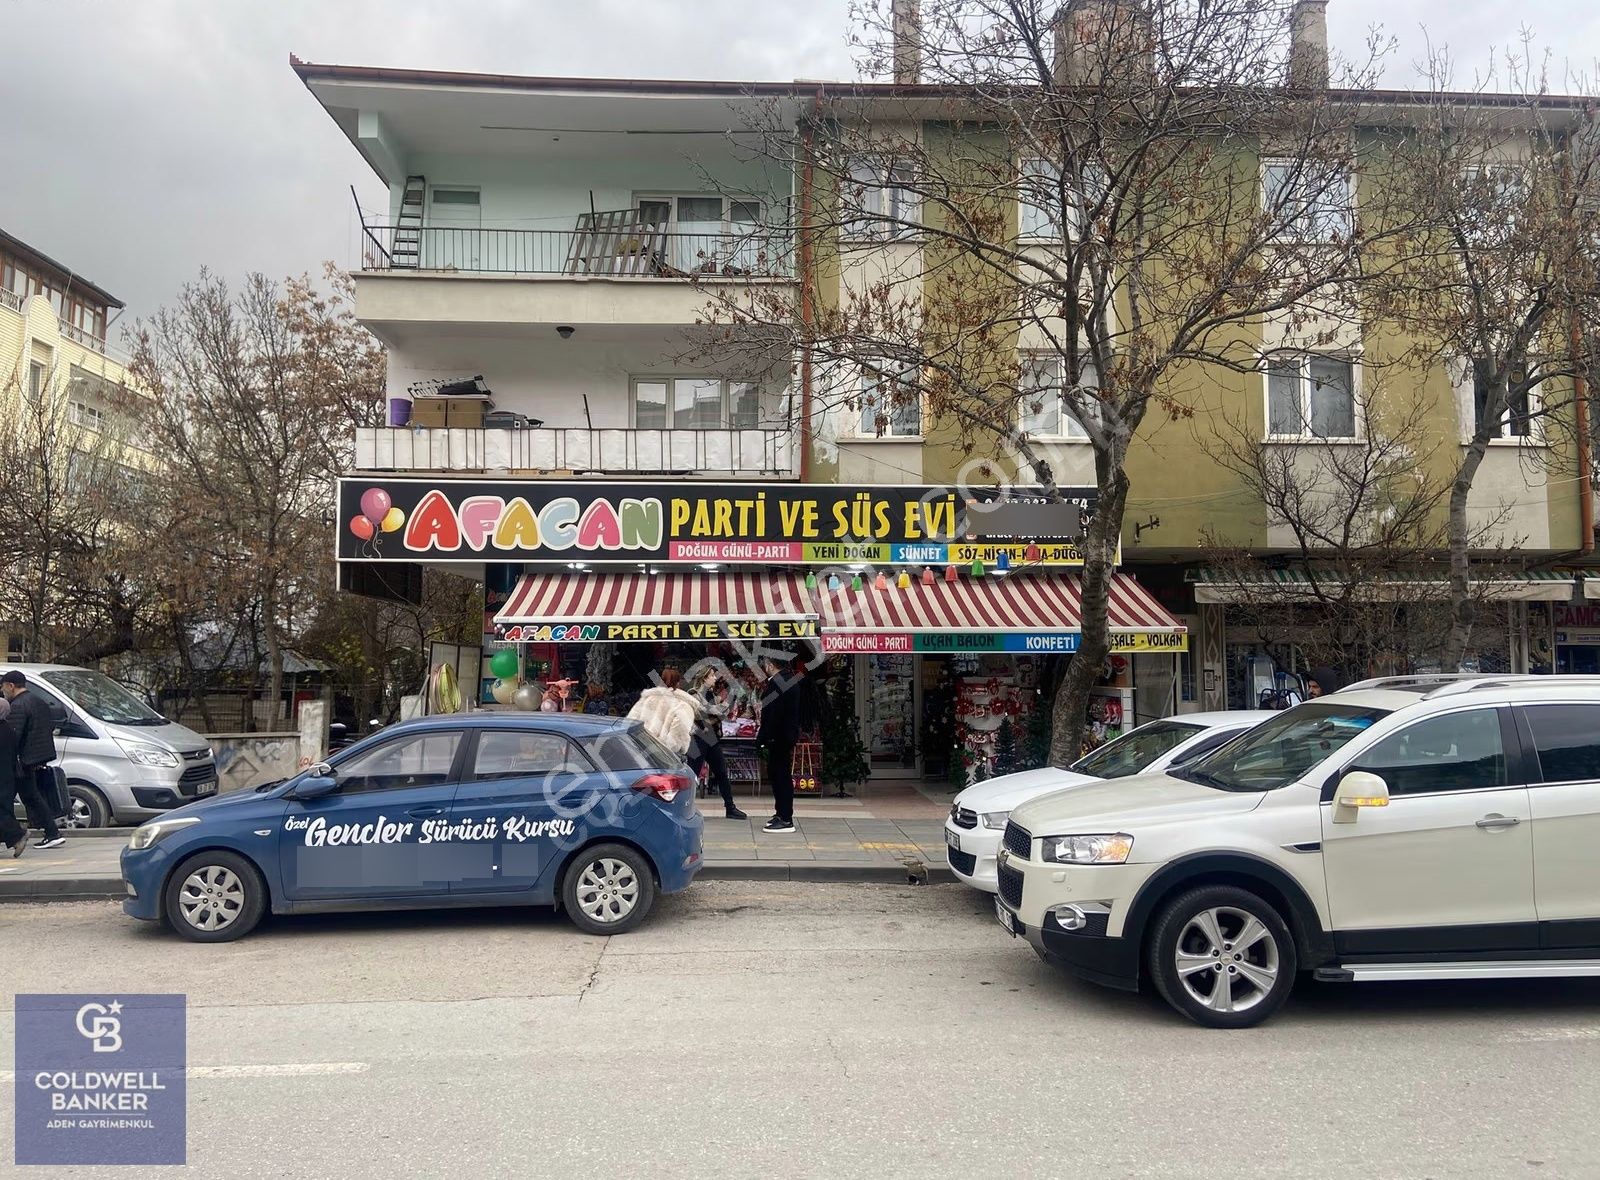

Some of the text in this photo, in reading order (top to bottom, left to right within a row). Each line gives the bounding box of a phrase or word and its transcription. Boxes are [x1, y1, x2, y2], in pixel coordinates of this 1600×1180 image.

[403, 489, 956, 551] AFACAN PARTİ VE SÜS EVİ
[677, 541, 790, 559] DOĞUM GÜNÜ-PARTİ
[812, 541, 881, 560] YENİ DOĞAN
[898, 544, 942, 560] SÜNNET
[504, 620, 815, 641] AFACAN PARTİ VE SÜS EVİ
[826, 635, 854, 650] DOĞUM
[856, 634, 878, 650] GÜNÜ
[885, 634, 908, 650] PARTİ
[922, 634, 995, 650] UÇAN BALON
[1026, 634, 1075, 650] KONFETİ
[1147, 634, 1183, 648] VOLKAN
[285, 815, 310, 831] Özel
[418, 817, 499, 844] Sürücü
[502, 815, 575, 843] Kursu
